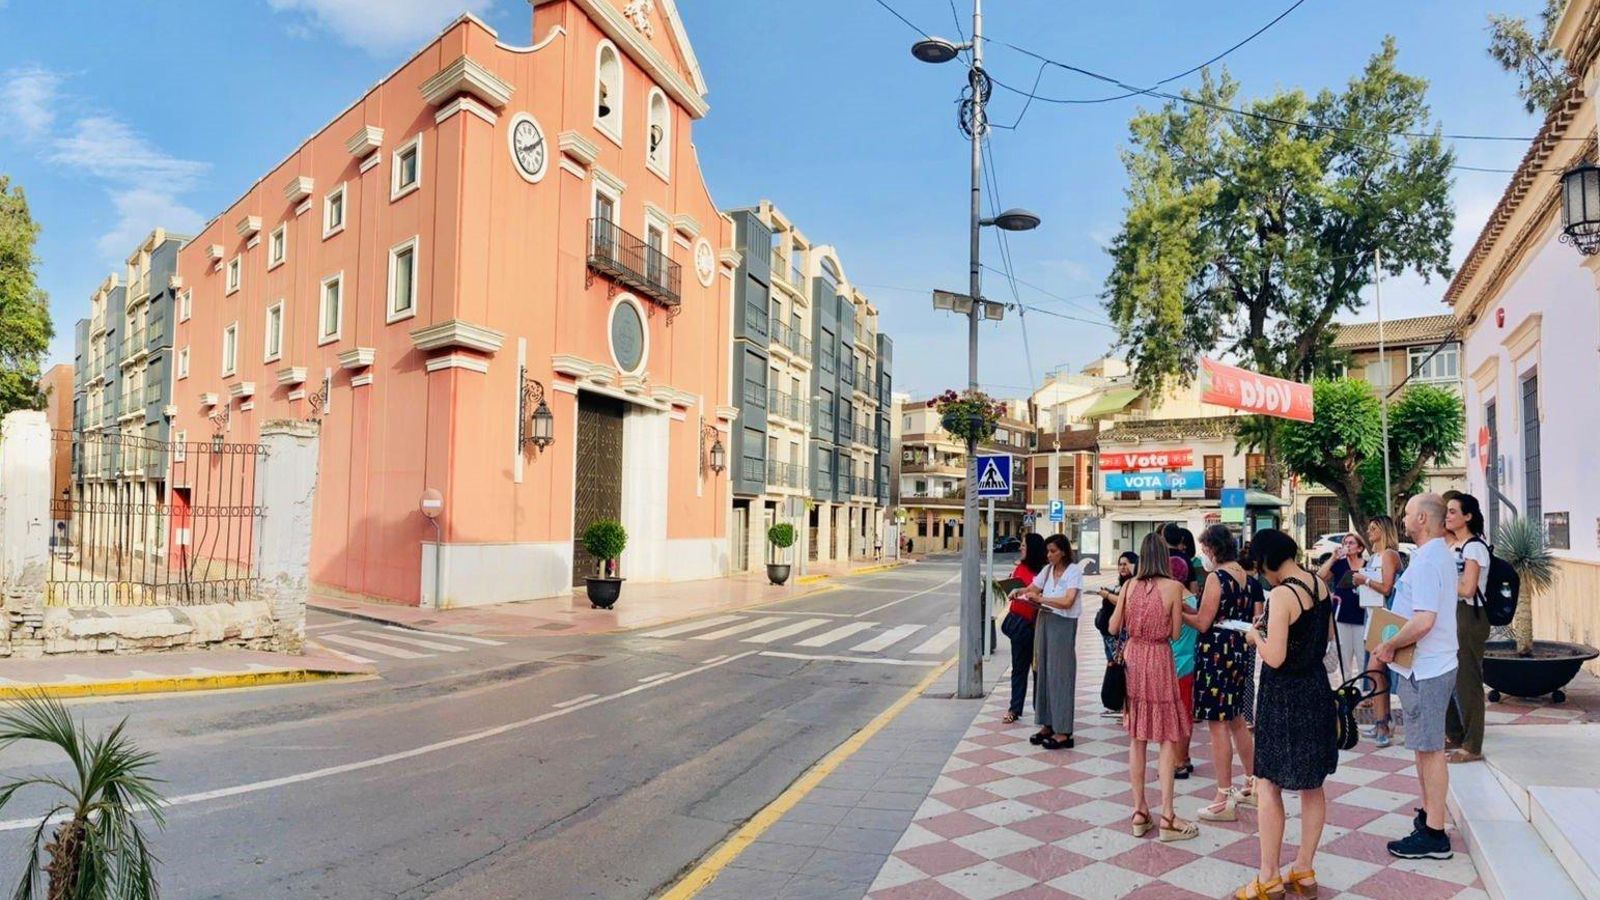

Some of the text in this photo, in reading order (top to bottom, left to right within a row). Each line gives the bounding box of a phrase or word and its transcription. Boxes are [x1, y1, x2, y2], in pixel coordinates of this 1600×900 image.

[1124, 454, 1168, 467] Vota
[1124, 476, 1162, 487] VOTA
[1051, 501, 1062, 514] P
